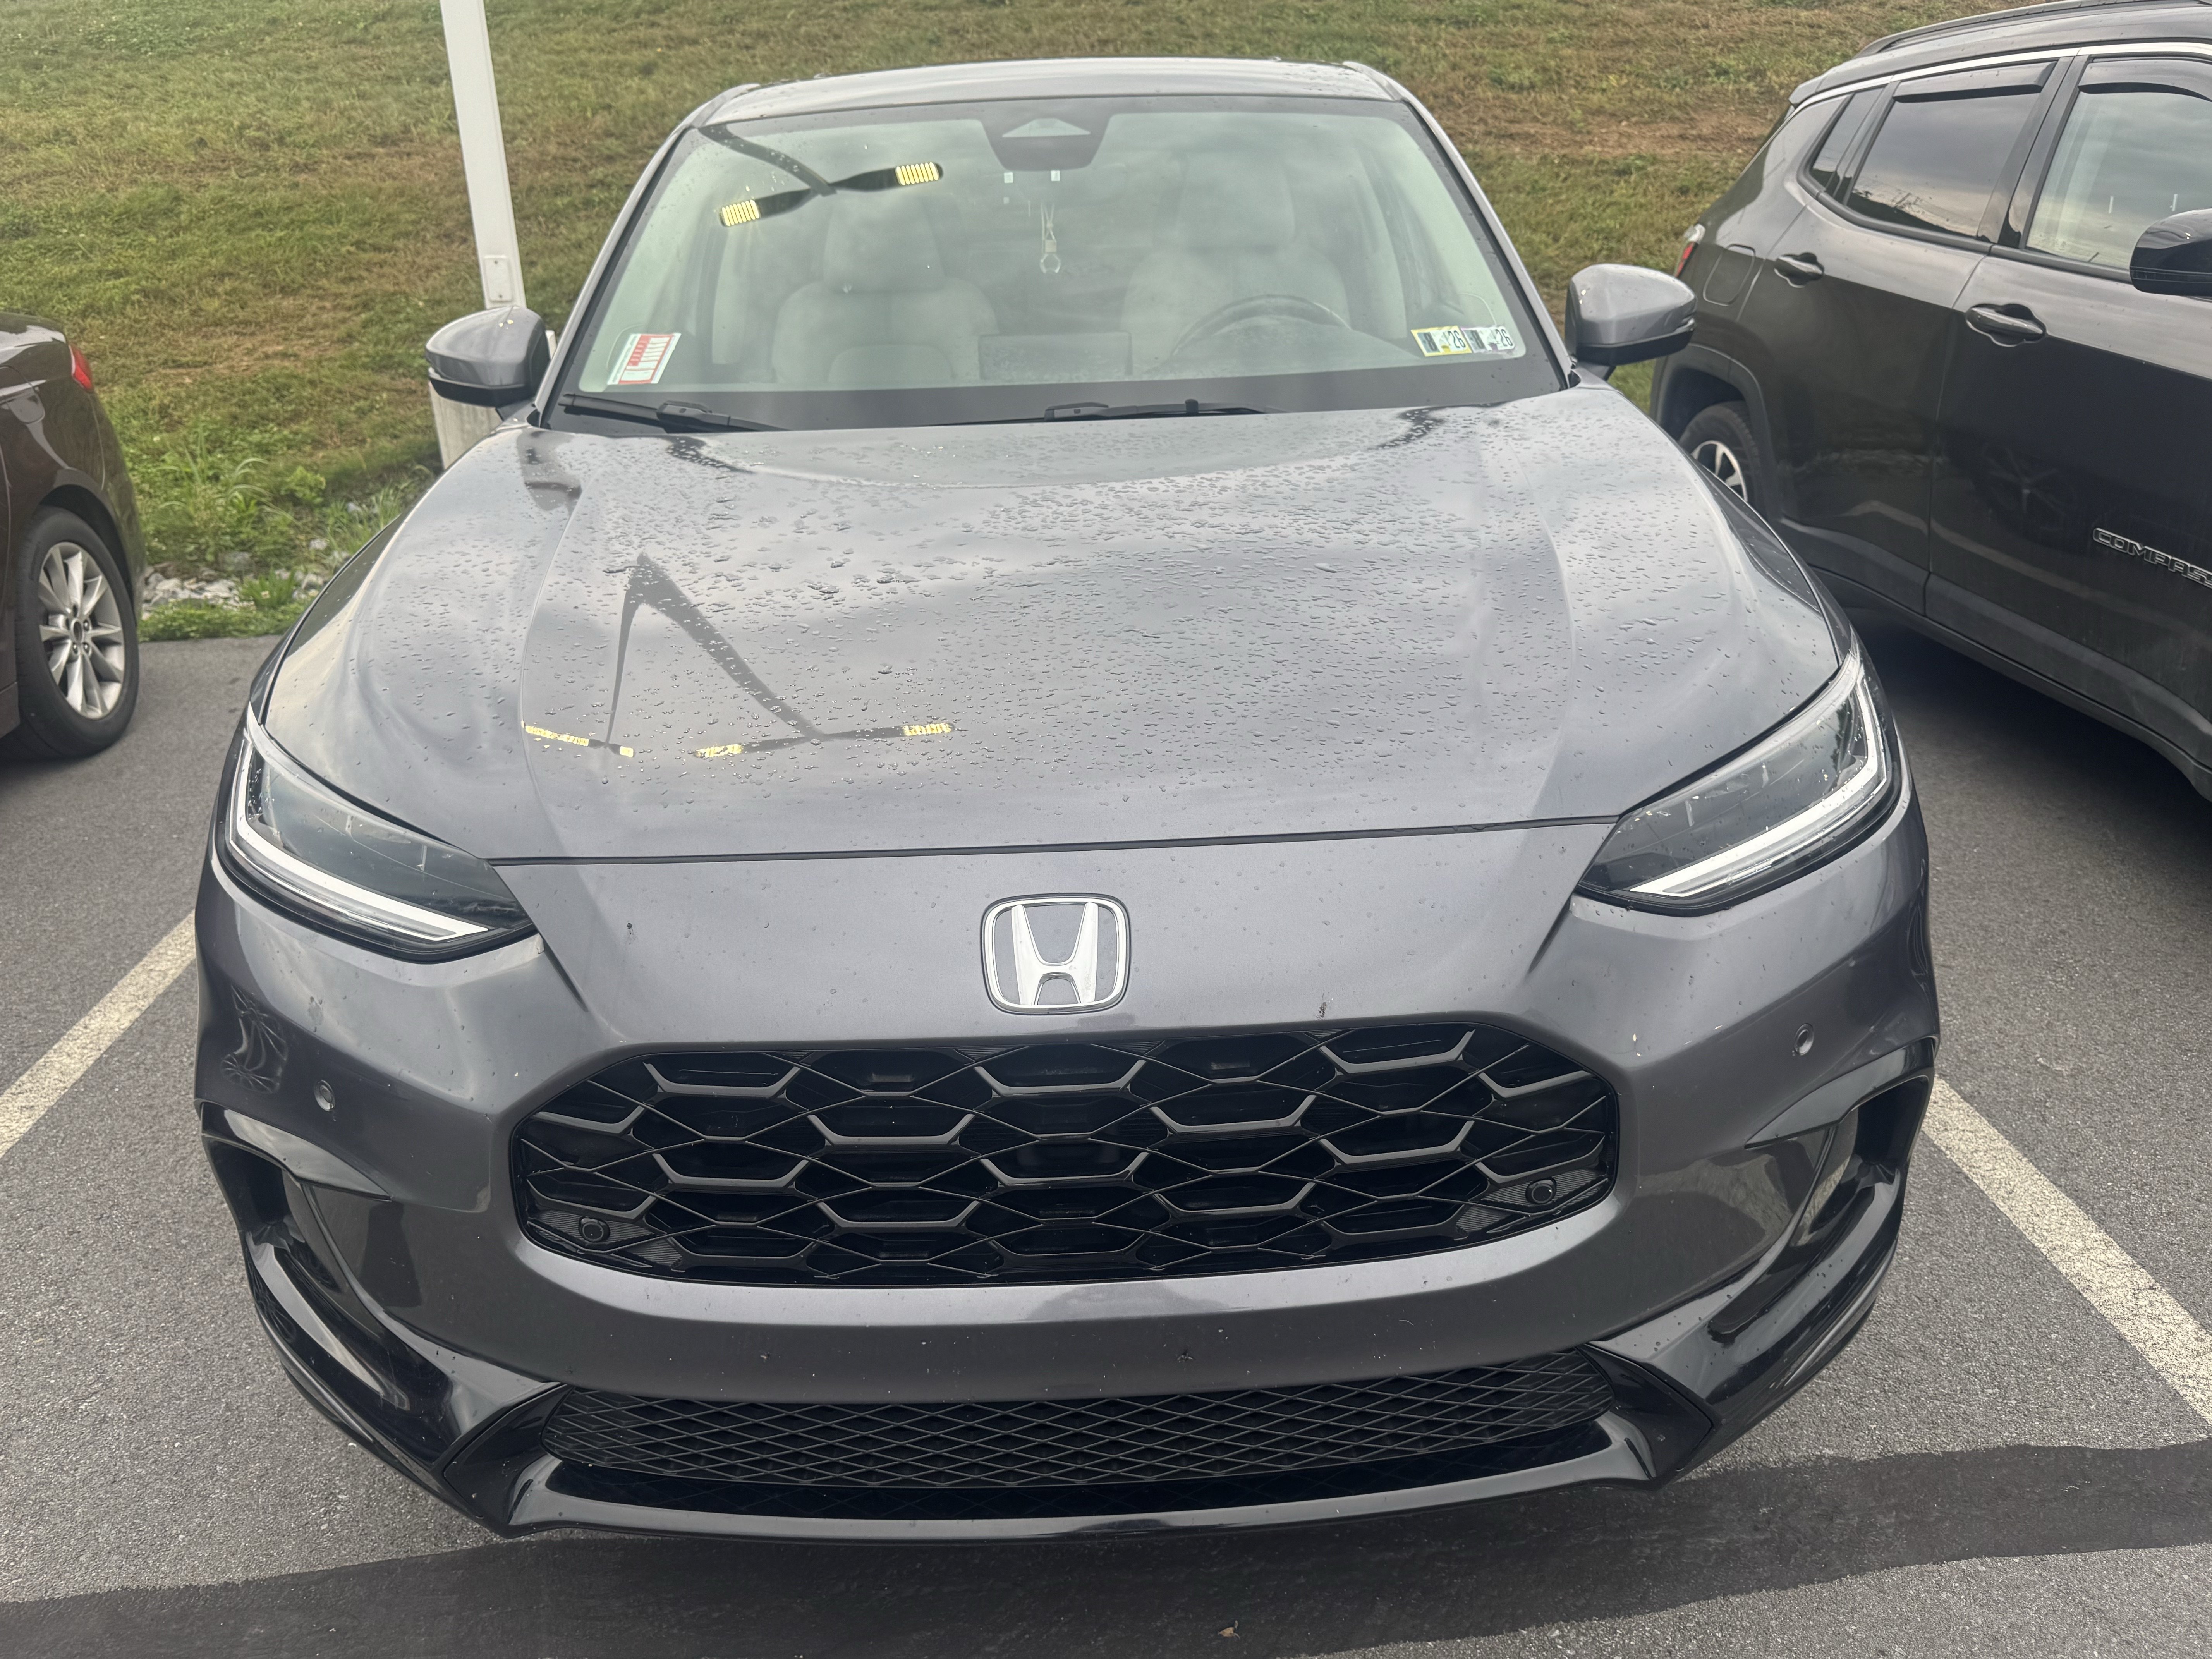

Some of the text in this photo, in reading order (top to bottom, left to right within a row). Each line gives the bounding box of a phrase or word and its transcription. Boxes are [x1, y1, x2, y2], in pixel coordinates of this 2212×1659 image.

[1448, 330, 1466, 348] 26
[1495, 329, 1513, 347] 26
[2093, 527, 2212, 589] COMPAS
